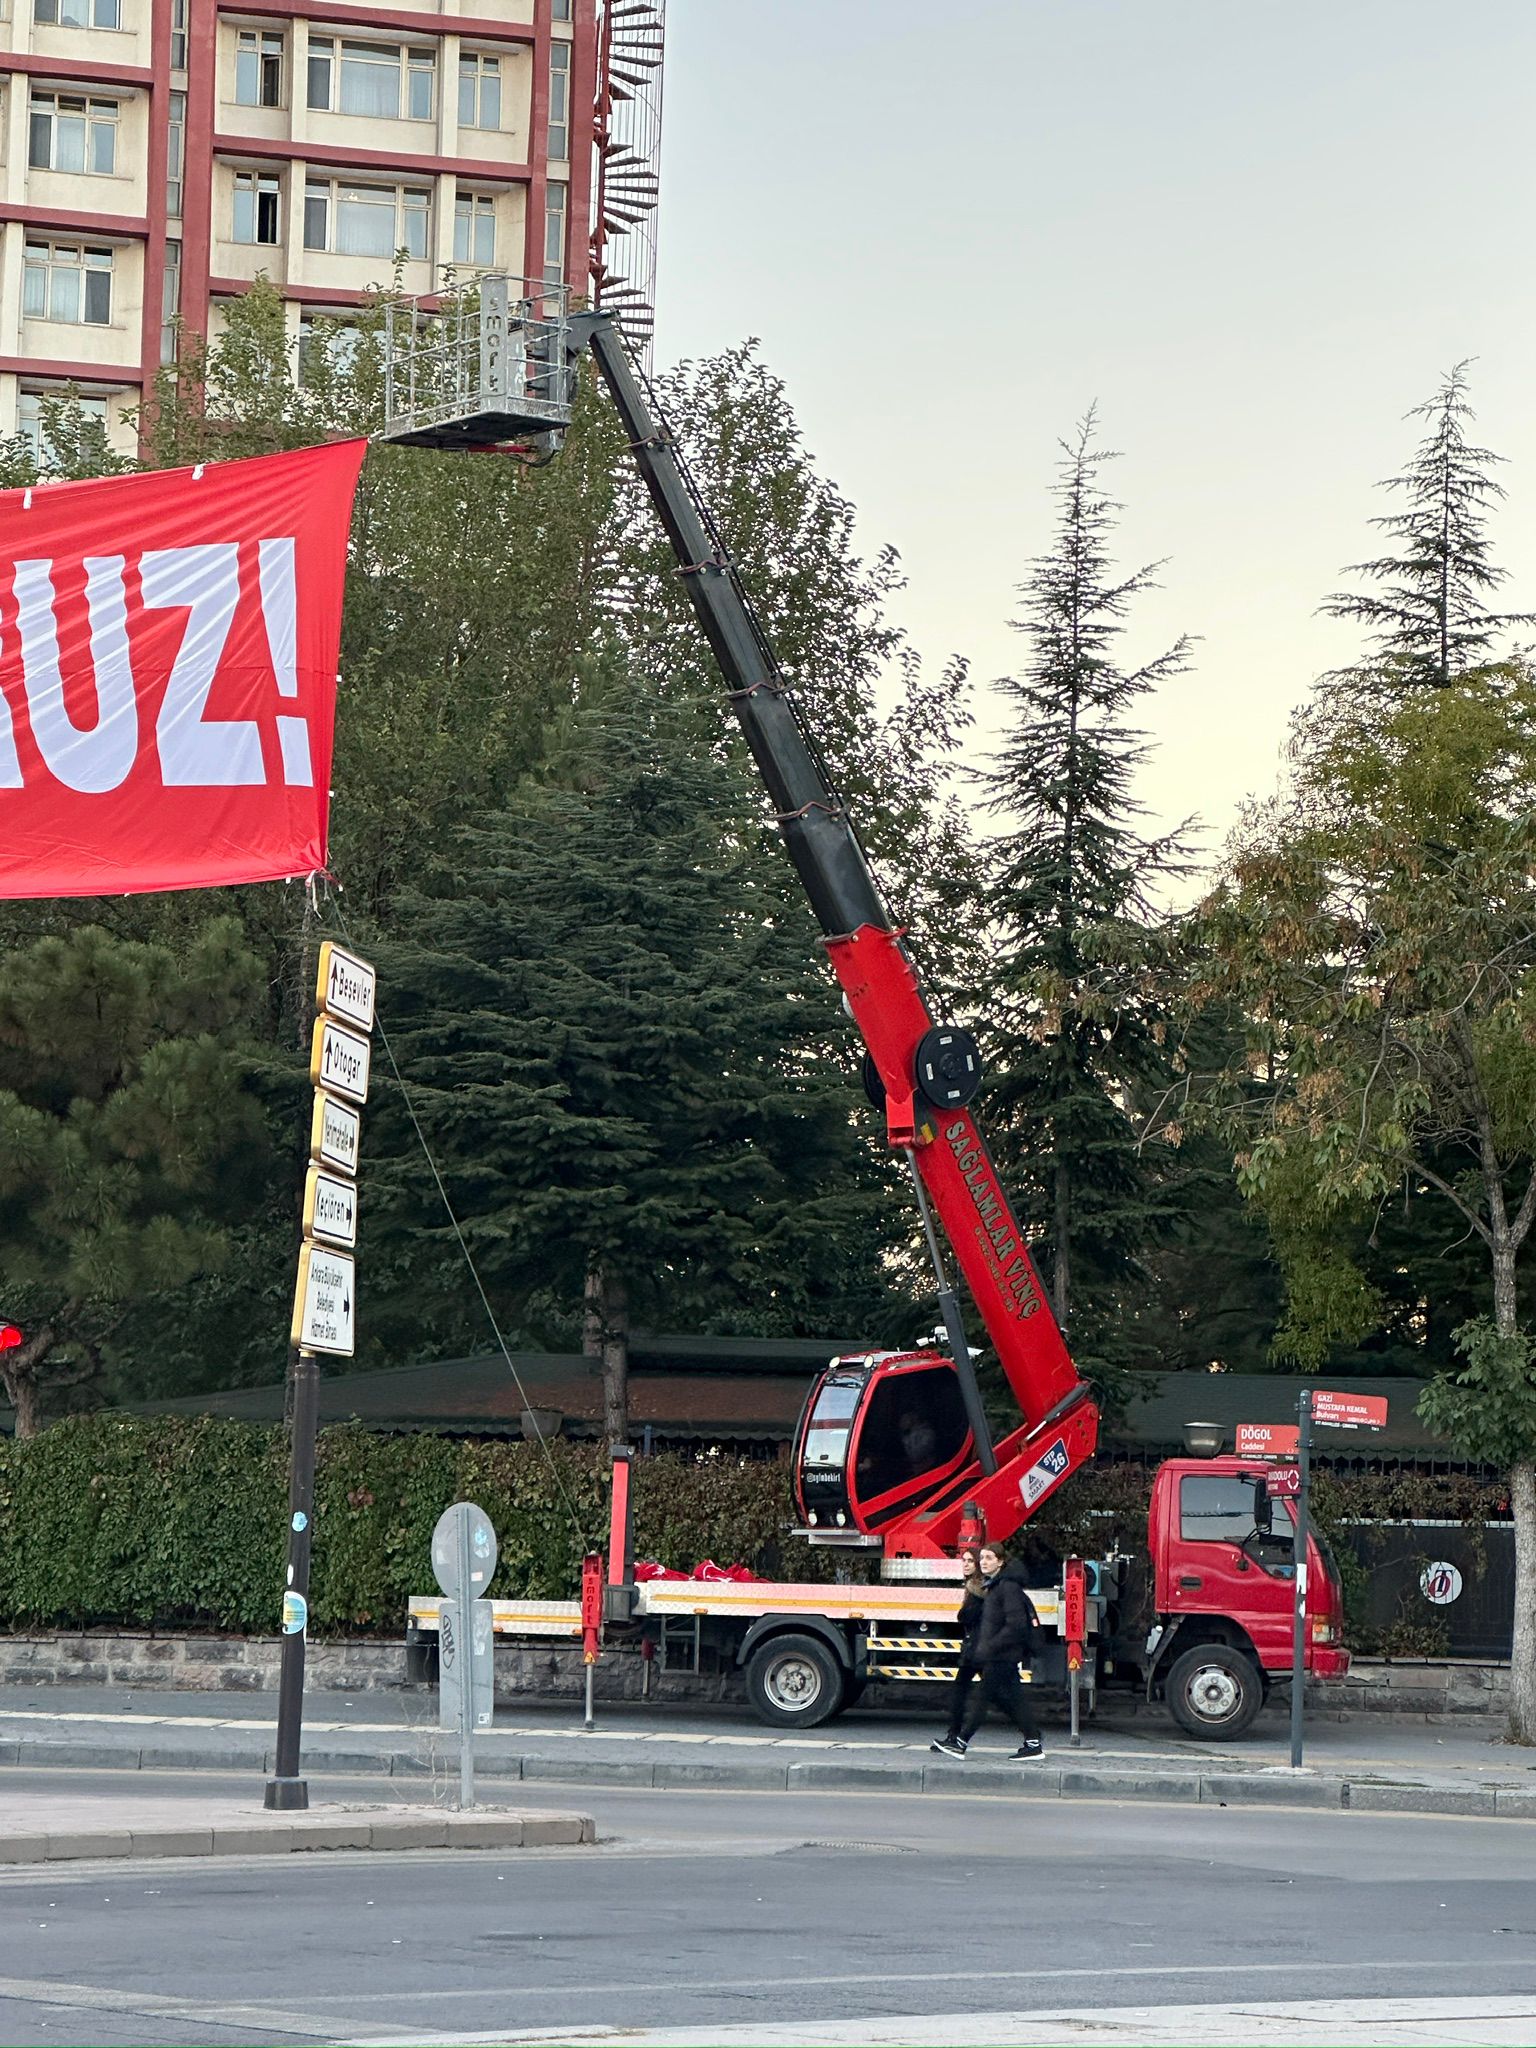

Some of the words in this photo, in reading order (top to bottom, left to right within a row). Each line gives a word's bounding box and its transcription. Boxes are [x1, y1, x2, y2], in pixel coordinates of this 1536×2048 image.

[0, 537, 313, 794] UZ!
[338, 967, 371, 1009] Beşevler
[333, 1042, 361, 1084] Otogar
[316, 1188, 345, 1223] Keçiören
[945, 1120, 1017, 1262] SAĞLAMLAR
[1005, 1256, 1042, 1321] VİNÇ
[1316, 1403, 1346, 1412] MUSTAFA
[1346, 1405, 1369, 1415] KEMAL
[1240, 1425, 1273, 1441] DÖGOL
[1240, 1442, 1265, 1451] Caddesi
[1043, 1450, 1056, 1466] STP
[1051, 1452, 1066, 1473] 26
